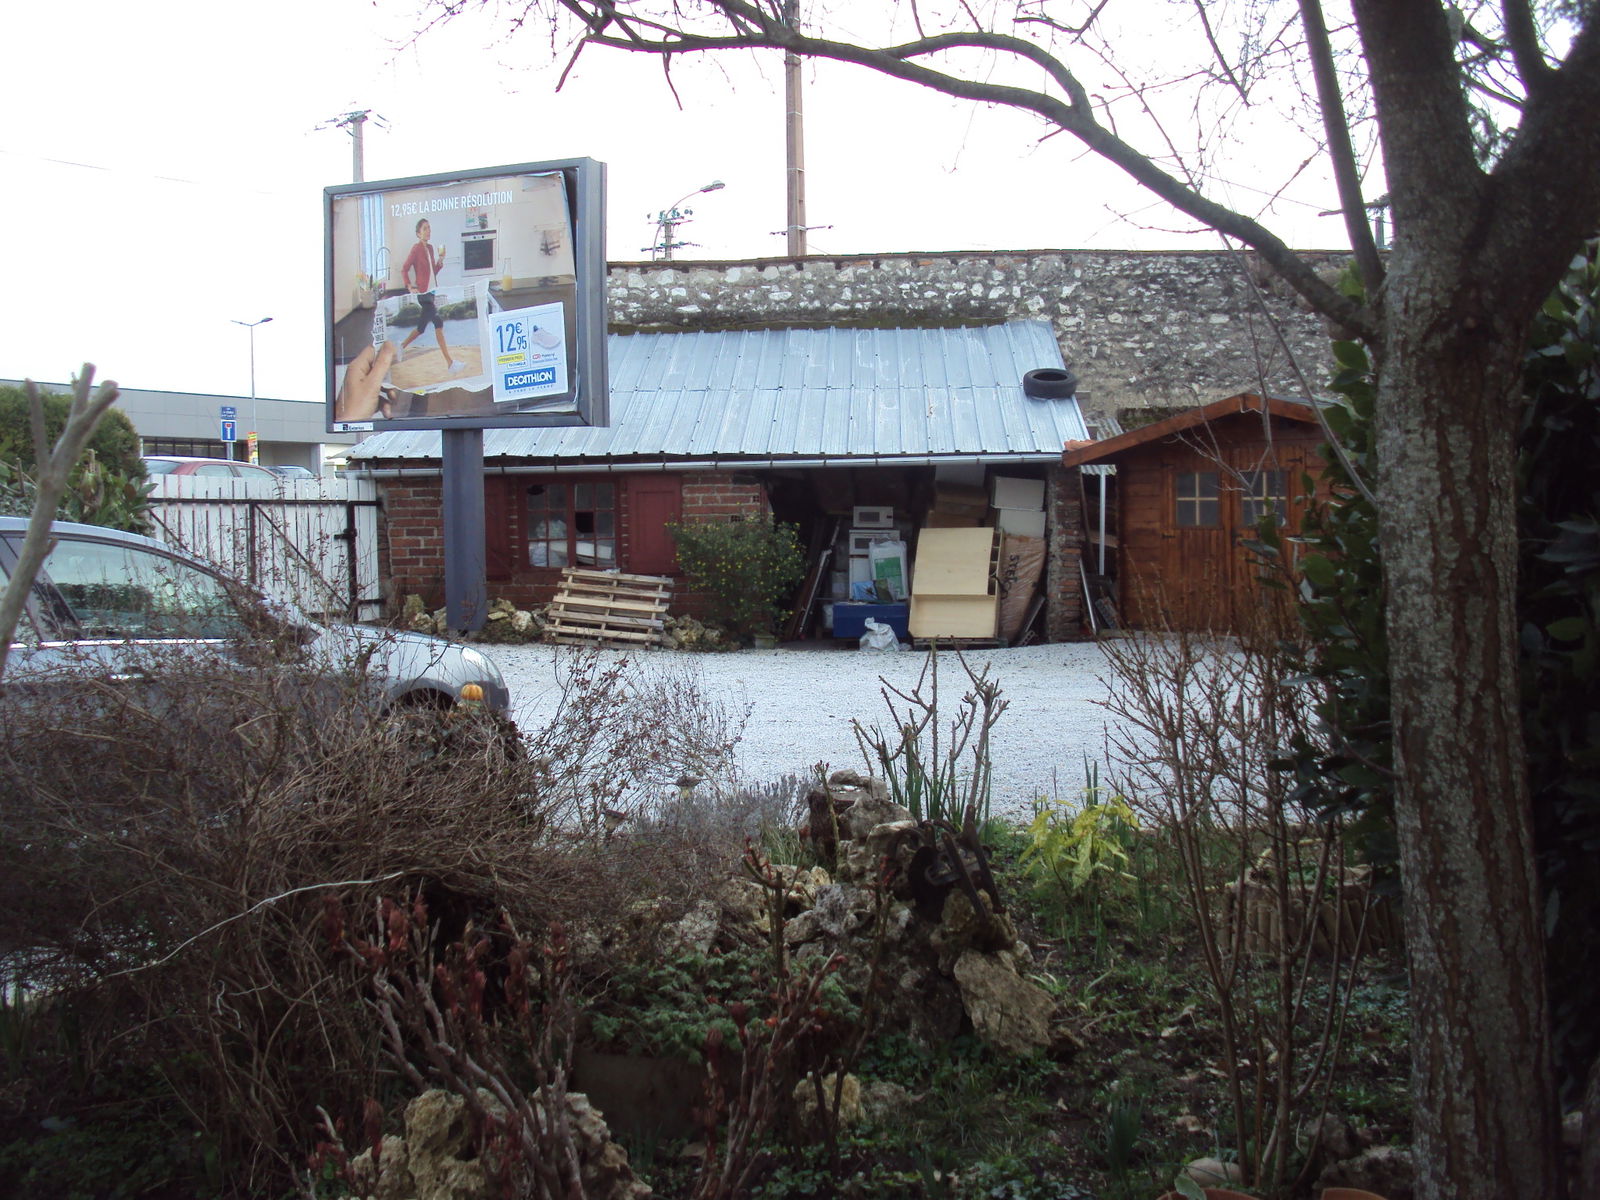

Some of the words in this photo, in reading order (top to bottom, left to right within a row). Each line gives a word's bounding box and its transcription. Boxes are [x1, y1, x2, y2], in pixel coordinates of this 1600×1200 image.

[419, 201, 430, 214] LA
[431, 196, 459, 212] BONNE
[461, 190, 513, 208] RÉSOLUTION
[507, 371, 553, 387] DECATHLON
